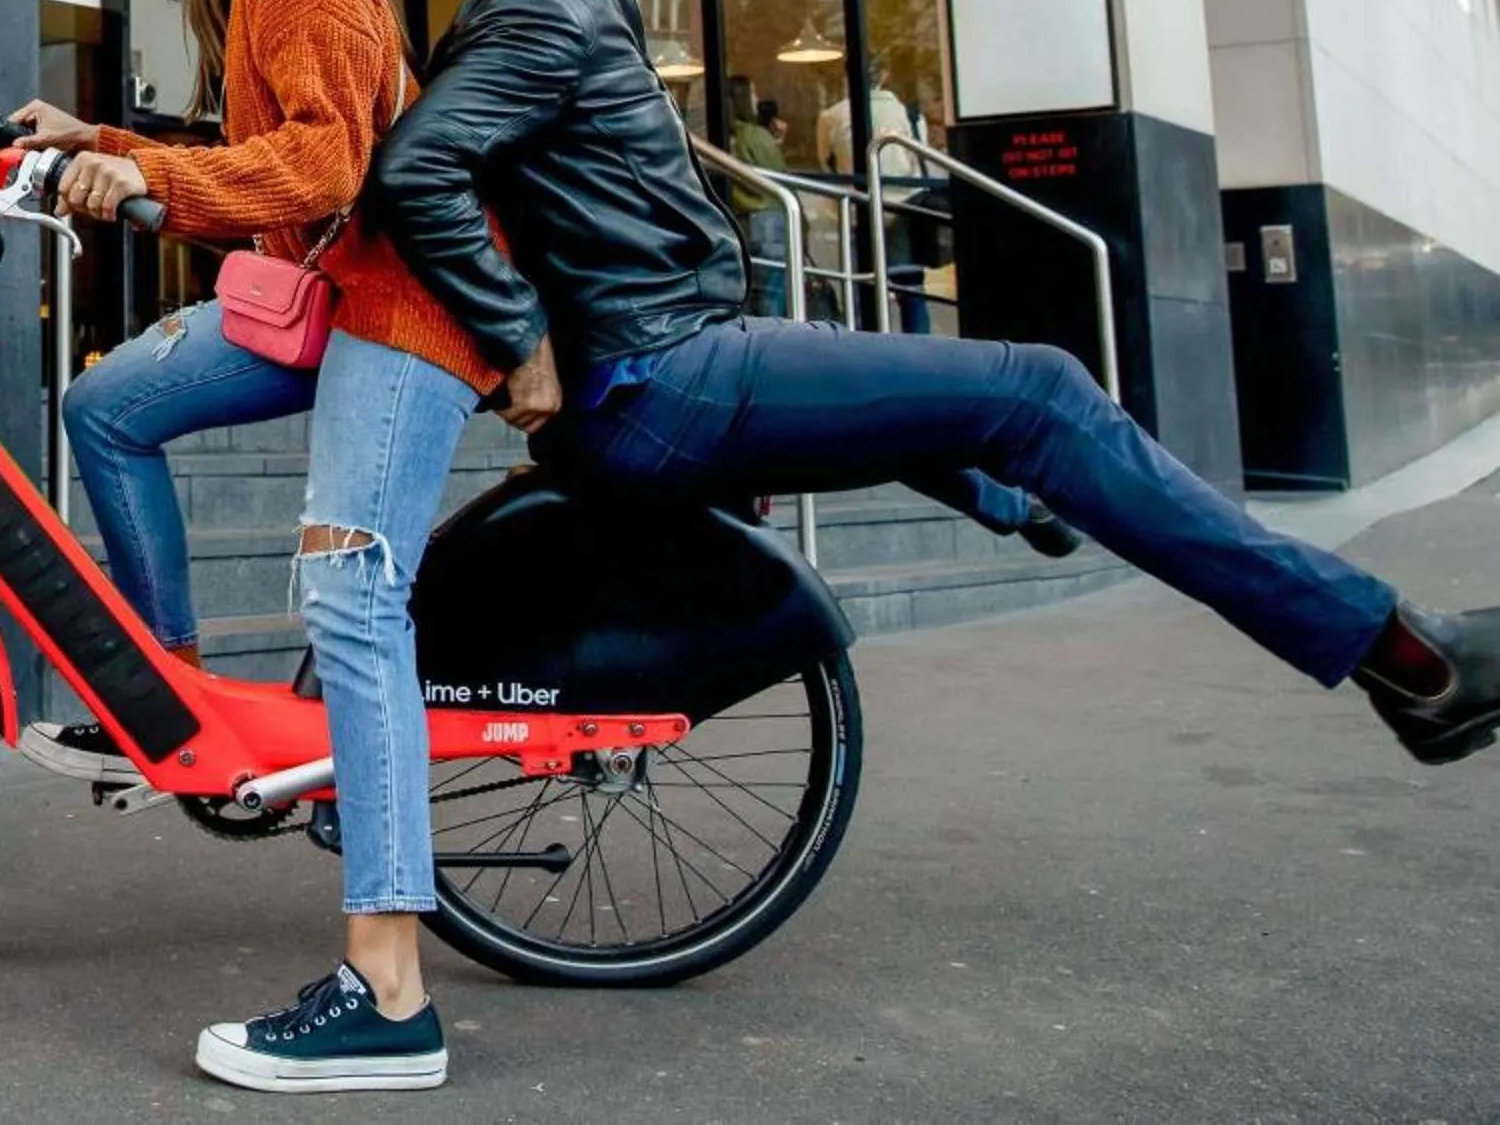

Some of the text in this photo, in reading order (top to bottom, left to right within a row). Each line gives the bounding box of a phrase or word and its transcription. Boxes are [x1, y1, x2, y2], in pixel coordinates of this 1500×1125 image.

[1012, 131, 1066, 145] PLEASE
[421, 679, 560, 706] ime + Uber
[482, 722, 529, 742] JUMP
